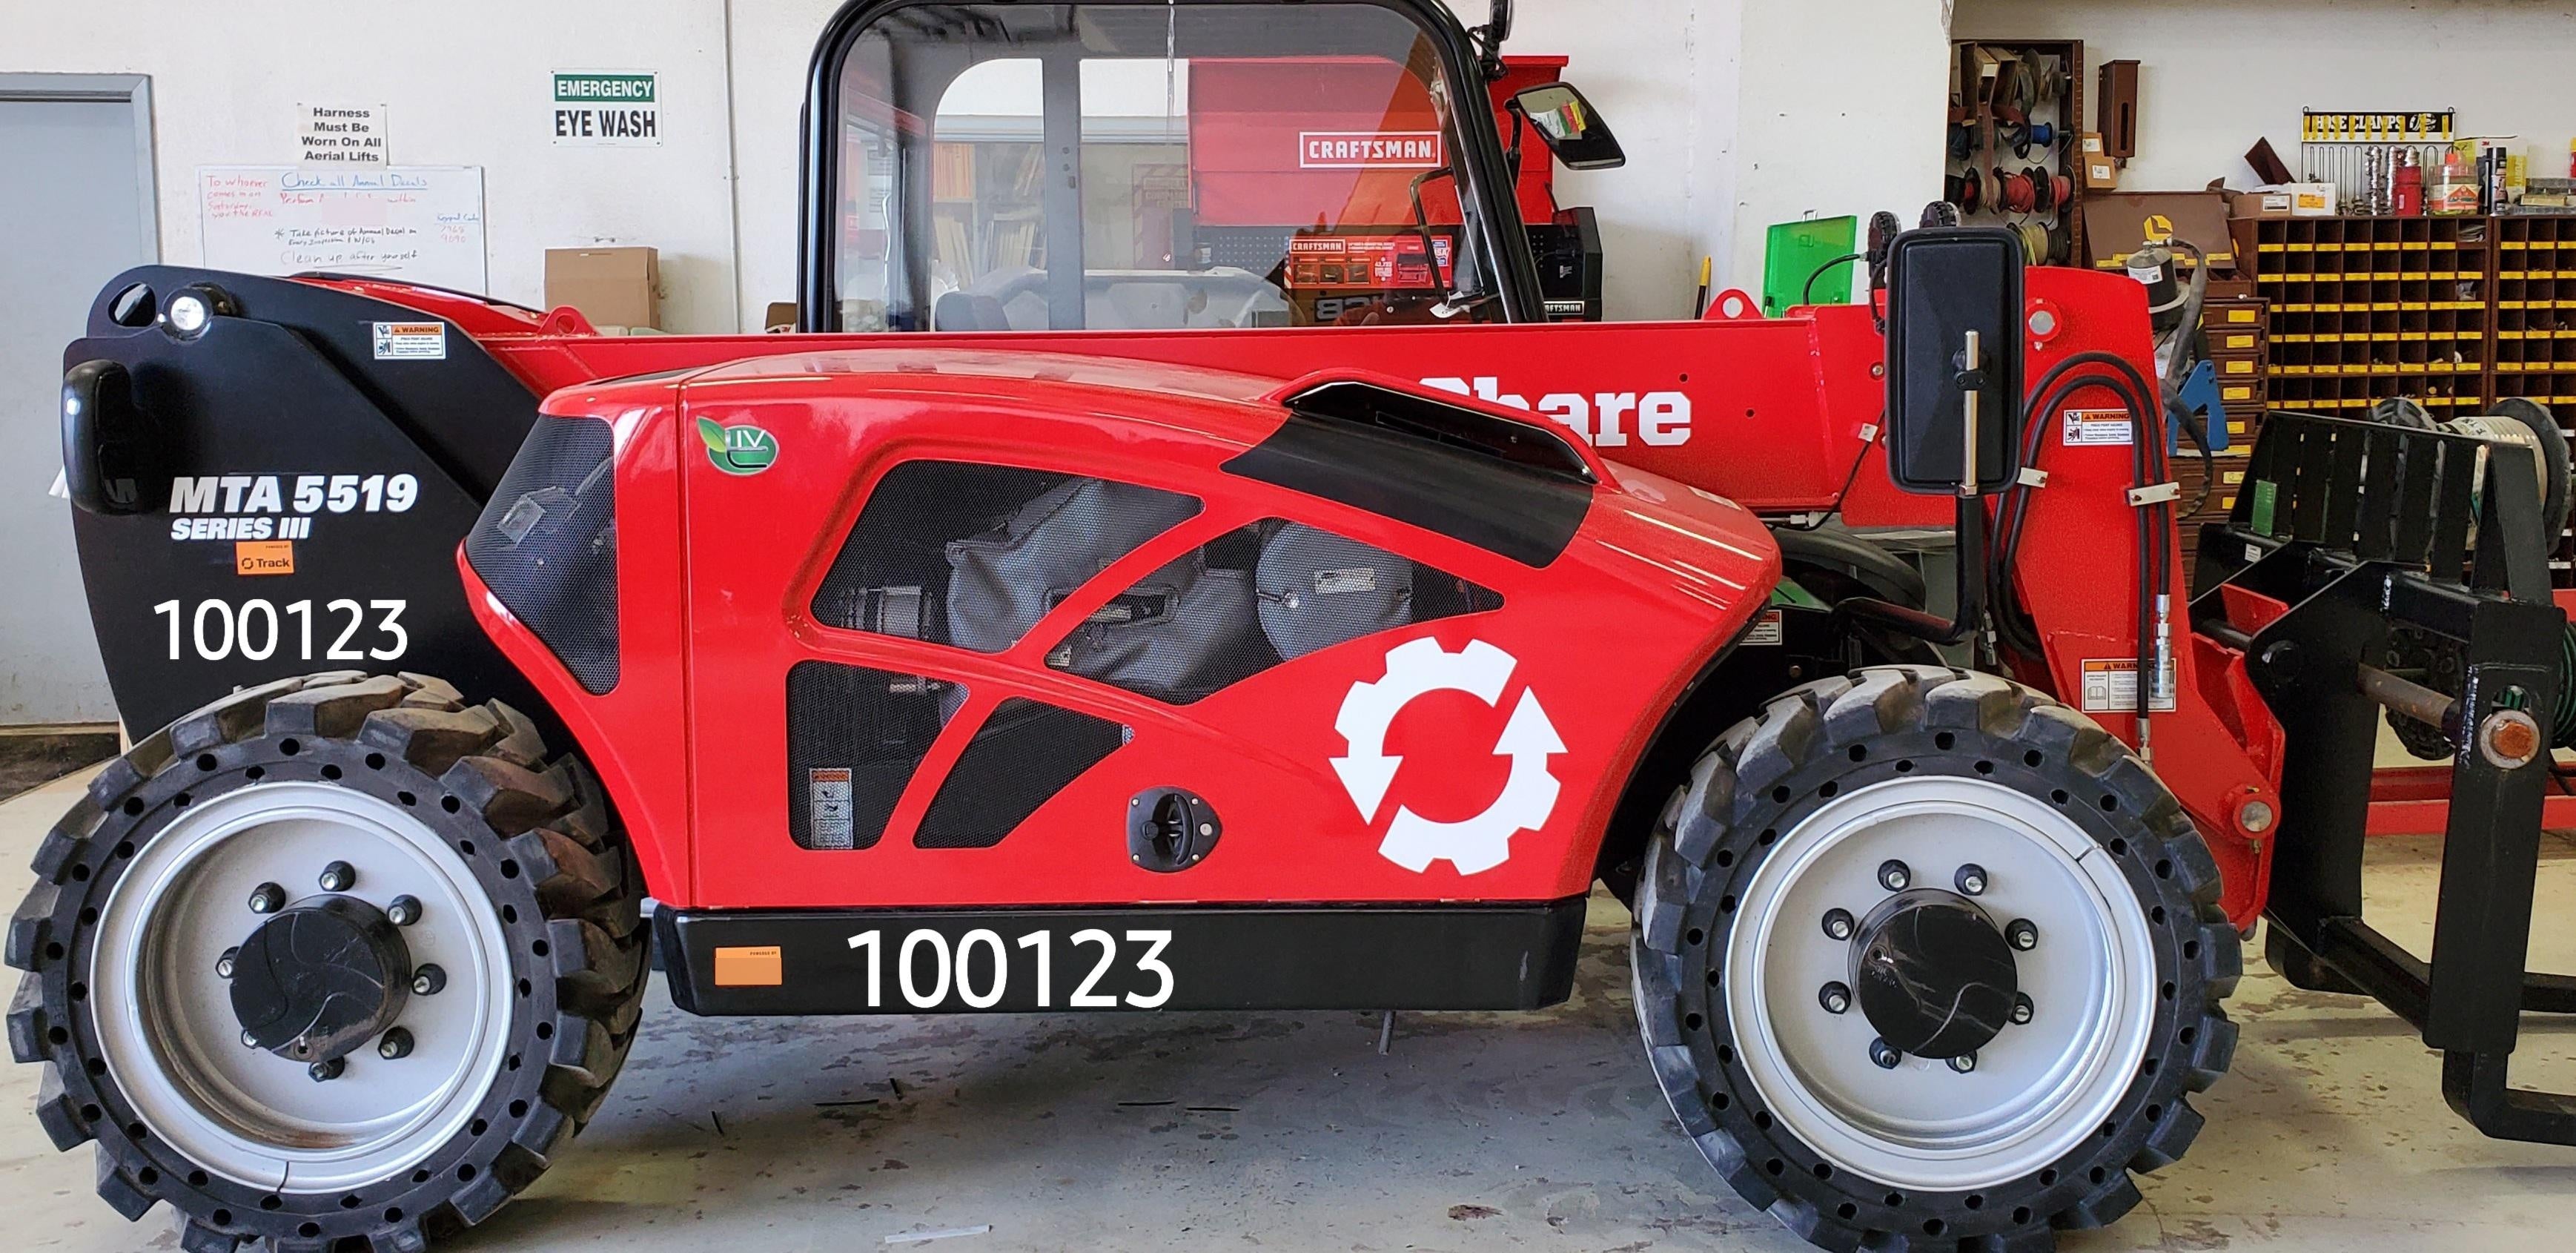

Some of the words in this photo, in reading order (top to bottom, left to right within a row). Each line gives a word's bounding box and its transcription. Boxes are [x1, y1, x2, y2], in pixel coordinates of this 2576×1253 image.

[557, 80, 652, 97] EMERGENCY
[313, 107, 371, 118] Harness
[314, 122, 348, 132] Must
[351, 122, 369, 133] Be
[556, 110, 593, 137] EYE
[599, 110, 656, 137] WASH
[301, 136, 337, 146] Worn
[341, 136, 360, 147] On
[364, 137, 381, 148] All
[304, 151, 345, 161] Aerial
[349, 151, 380, 162] Lifts
[1309, 140, 1432, 159] CRAFTSMAN
[206, 175, 221, 188] To
[282, 171, 322, 188] Check
[330, 174, 345, 186] all
[1292, 242, 1342, 251] CRAFTSMAN
[280, 250, 322, 265] Clean
[328, 254, 343, 263] up
[349, 250, 375, 261] after
[1544, 304, 1581, 312] AFTSMAN
[1418, 376, 1692, 447] are
[169, 475, 282, 514] MTA
[293, 474, 418, 513] 5519
[170, 517, 273, 540] SERIES
[277, 517, 312, 540] III
[256, 558, 290, 568] Track
